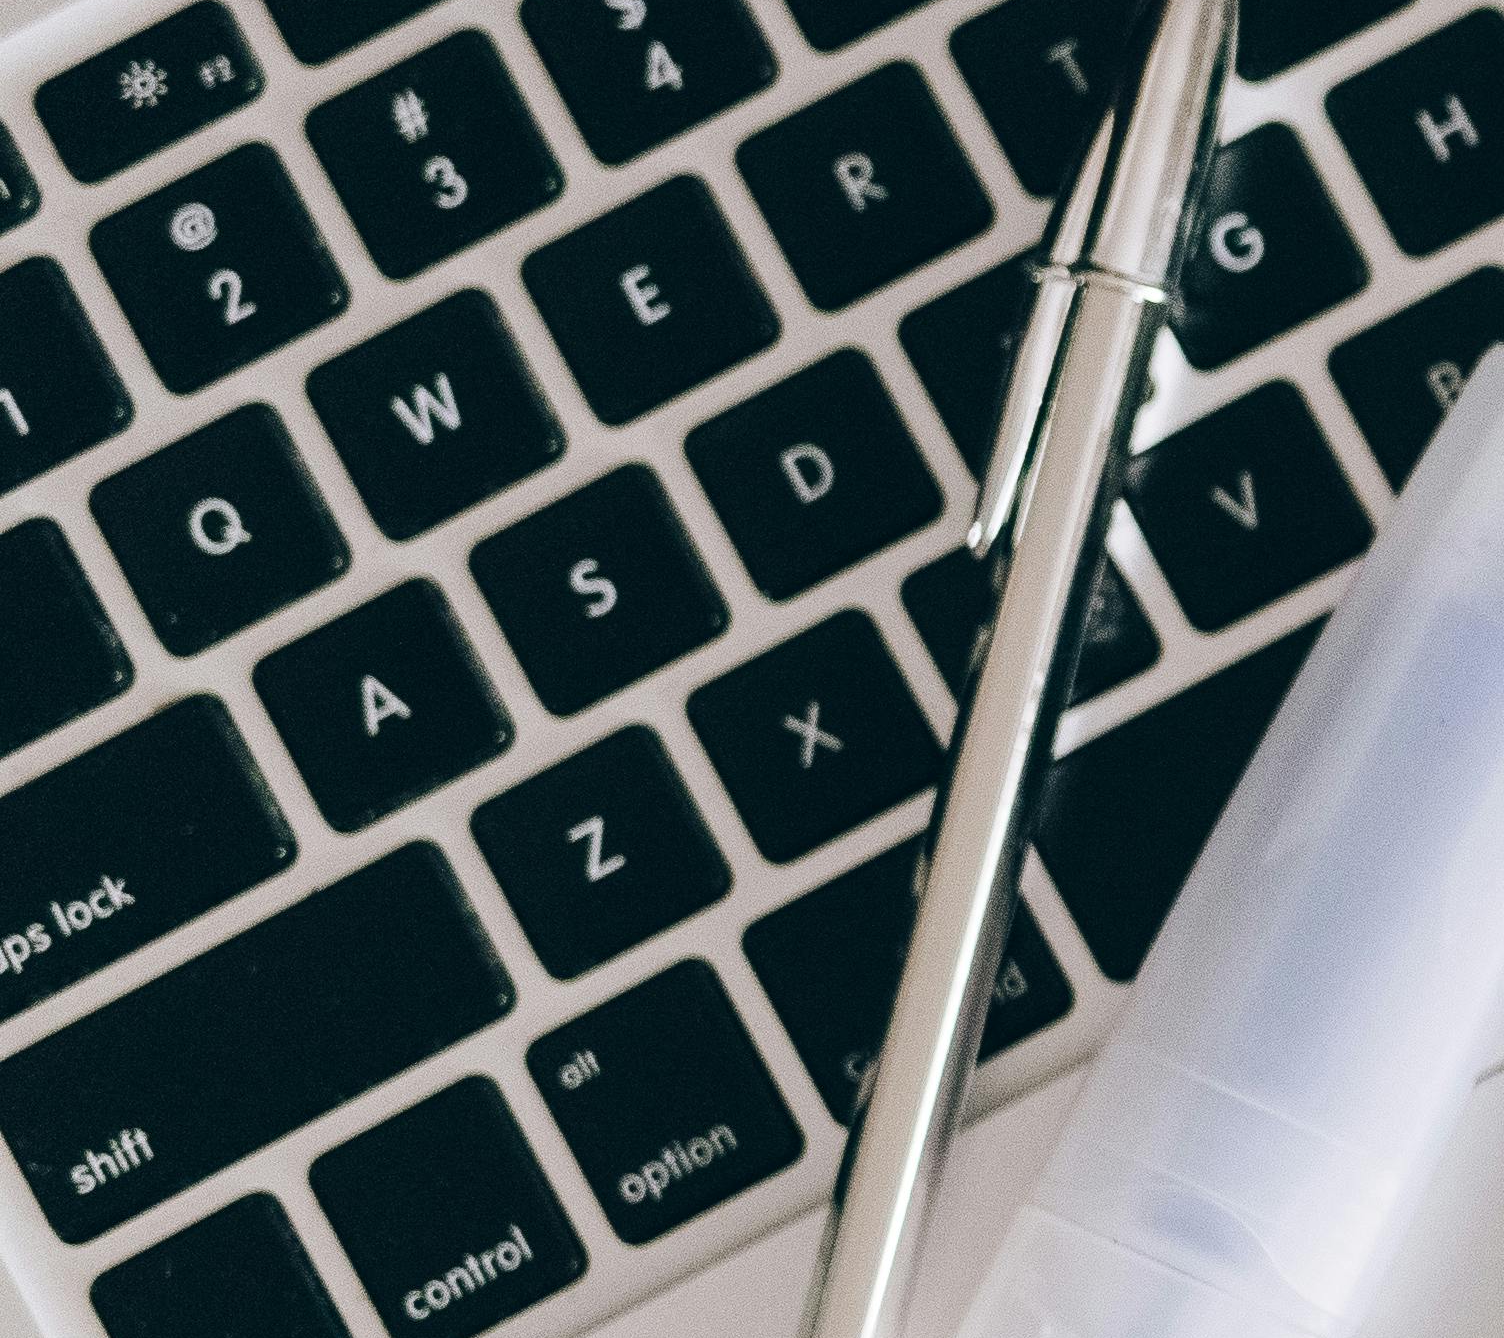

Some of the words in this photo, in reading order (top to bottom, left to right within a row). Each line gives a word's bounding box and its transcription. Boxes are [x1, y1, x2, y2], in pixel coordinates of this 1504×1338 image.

[646, 42, 683, 89] 4
[1049, 41, 1087, 90] T
[393, 90, 428, 141] #
[1417, 96, 1478, 161] H
[424, 156, 468, 209] 3
[835, 153, 885, 210] R
[170, 202, 217, 251] @
[1209, 212, 1264, 272] G
[208, 269, 256, 325] 2
[621, 265, 670, 325] E
[391, 373, 461, 444] W
[781, 443, 834, 503] D
[1213, 473, 1258, 528] V
[188, 497, 251, 555] Q
[569, 558, 618, 618] S
[361, 675, 411, 735] A
[785, 703, 841, 766] X
[568, 816, 625, 882] Z
[51, 876, 135, 936] lock
[560, 1051, 600, 1088] alt
[70, 1128, 154, 1195] shift
[620, 1126, 739, 1204] option
[404, 1225, 533, 1322] control
